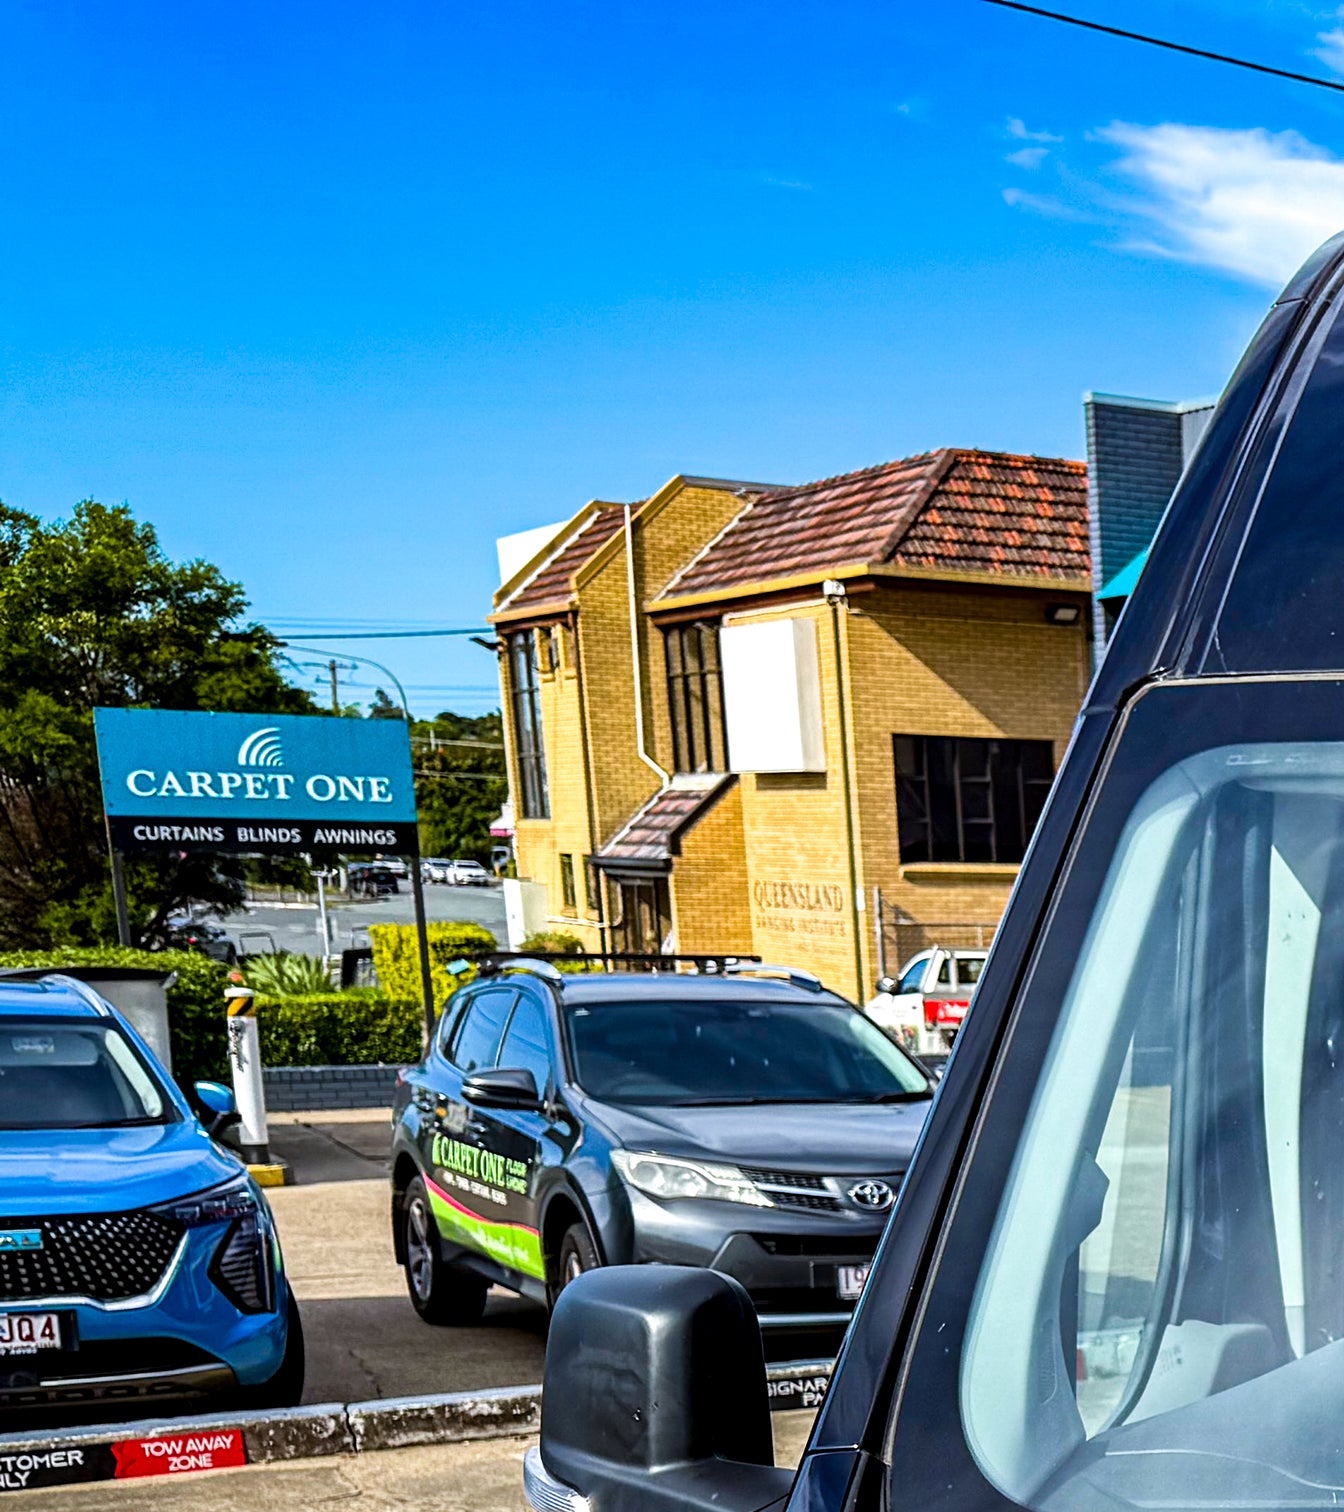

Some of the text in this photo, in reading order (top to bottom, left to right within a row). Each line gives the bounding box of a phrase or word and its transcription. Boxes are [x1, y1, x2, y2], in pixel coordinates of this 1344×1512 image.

[126, 769, 393, 803] CARPET ONE
[133, 825, 397, 845] CURTAINS BLINDS AWNINGS
[480, 1150, 506, 1187] ONE
[141, 1435, 234, 1457] TOW AWAY
[0, 1450, 84, 1473] TOMER
[168, 1453, 213, 1471] ZONE
